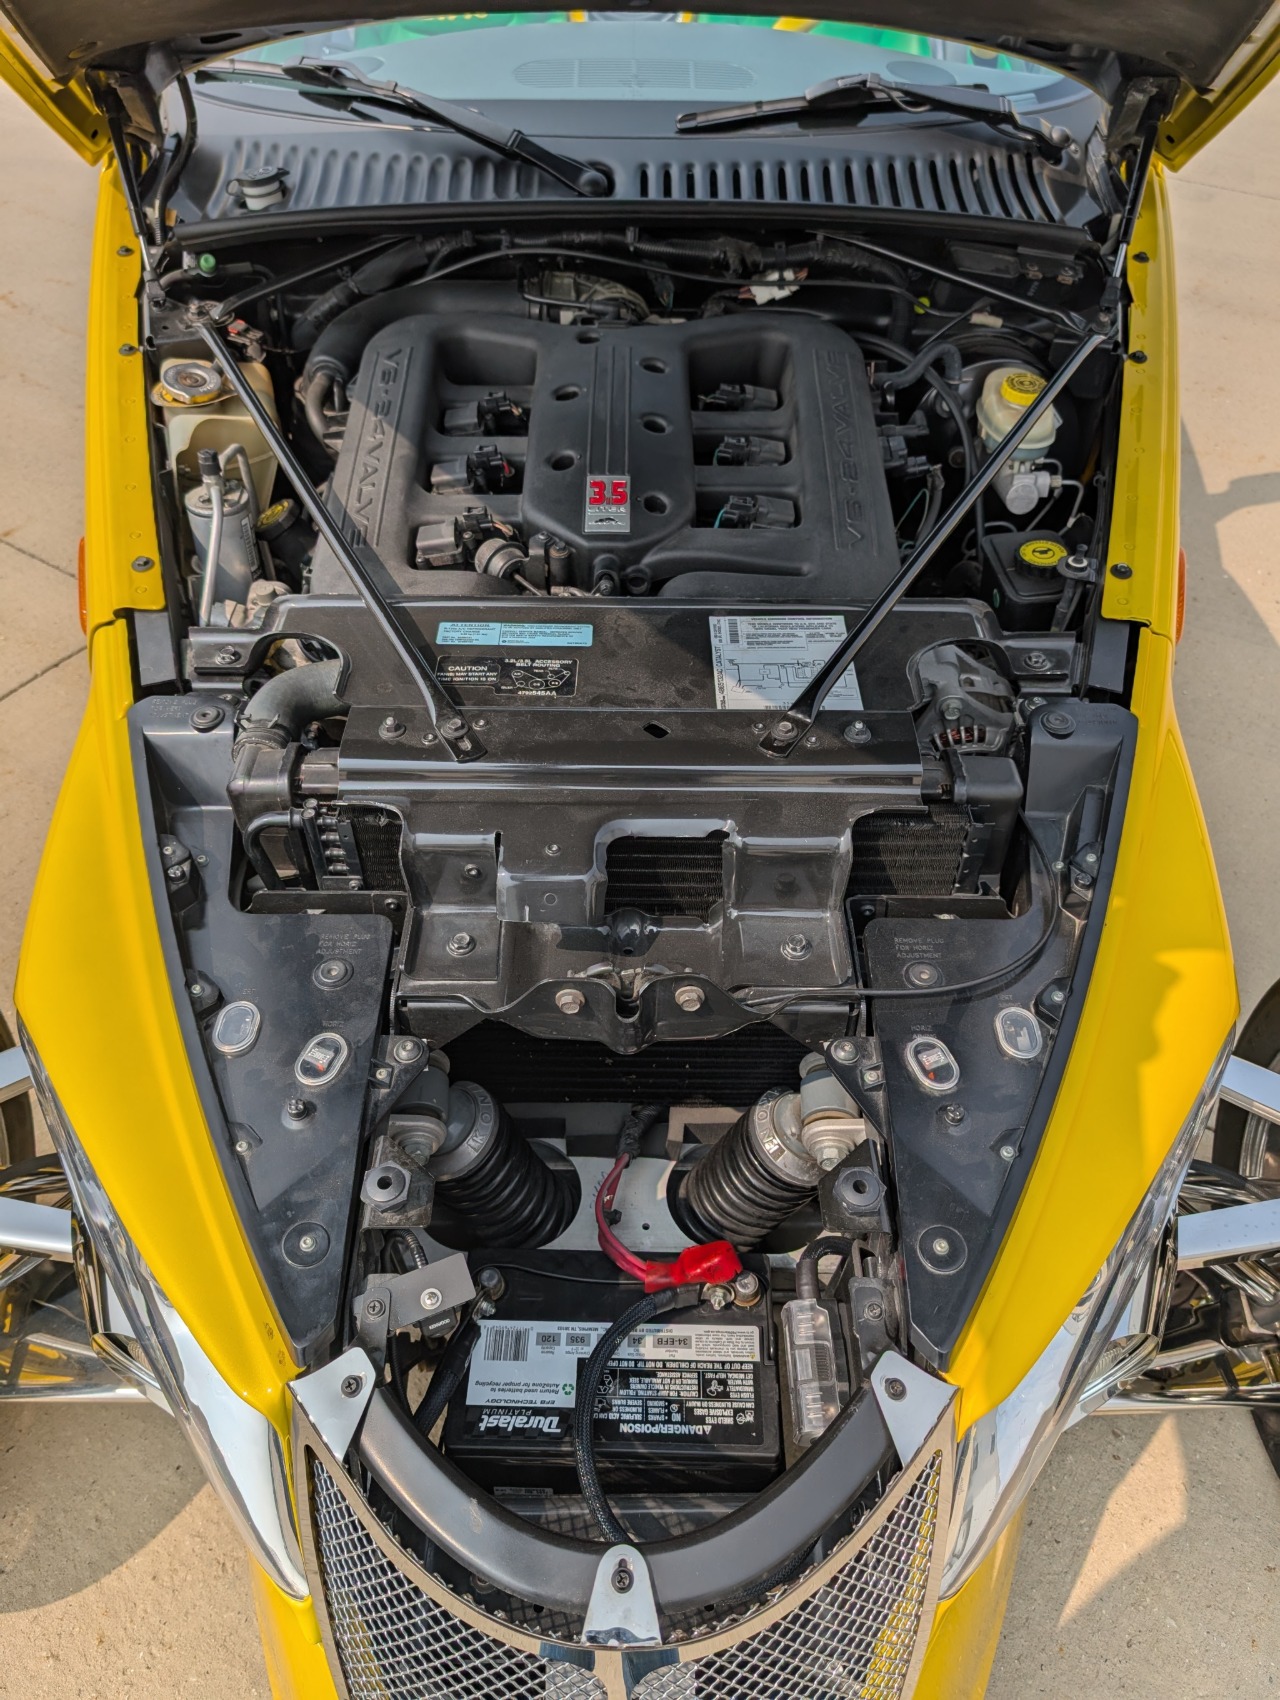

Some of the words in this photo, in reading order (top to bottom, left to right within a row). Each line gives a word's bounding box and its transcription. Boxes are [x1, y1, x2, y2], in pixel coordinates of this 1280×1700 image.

[657, 1337, 688, 1345] 34-EFB
[672, 1413, 681, 1421] NO
[479, 1414, 561, 1433] Duralast
[620, 1423, 703, 1435] DANGER/POISON
